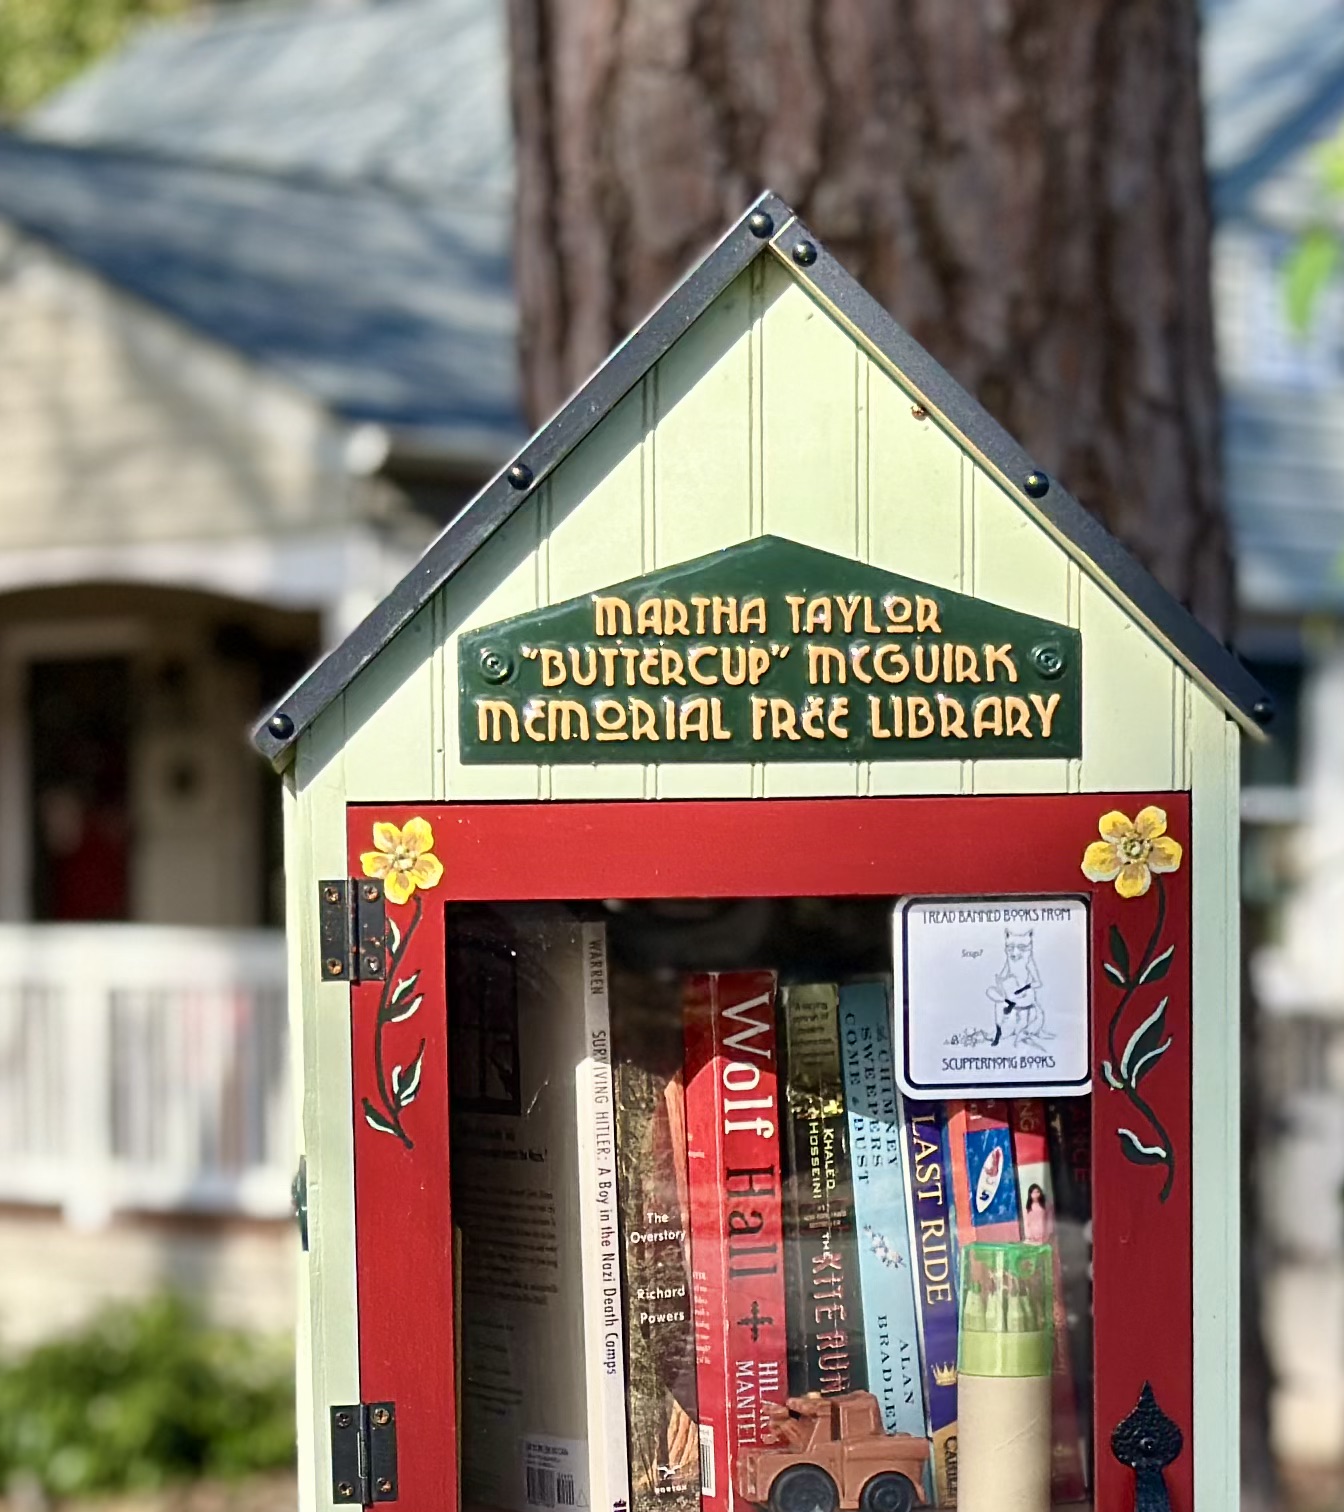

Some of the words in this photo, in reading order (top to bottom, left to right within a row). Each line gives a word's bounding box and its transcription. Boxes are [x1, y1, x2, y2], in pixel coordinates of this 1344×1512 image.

[592, 595, 767, 636] MARTHA
[785, 595, 942, 634] TAYLOR
[521, 644, 789, 687] "BUTTERCUP"
[808, 643, 1018, 684] MCGUIRK
[476, 697, 731, 743] MEMORIAL
[751, 696, 849, 740] FREE
[868, 693, 1060, 739] LIBRARY
[958, 909, 1001, 923] BANNED
[1004, 909, 1039, 922] BOOKS
[1041, 908, 1071, 921] FROM
[590, 940, 603, 995] WARREN
[592, 1031, 609, 1104] SURVIVING
[722, 992, 775, 1139] Wolf
[942, 1057, 1017, 1071] SCUPPERNONG
[1020, 1056, 1056, 1069] BOOKS
[845, 1012, 861, 1086] COME
[853, 1118, 870, 1185] DUST
[861, 1027, 884, 1168] SWEEPERS
[878, 1049, 899, 1166] CHIMNEY
[595, 1111, 612, 1161] HITLER:
[808, 1122, 822, 1199] HOSSEINI
[823, 1128, 836, 1190] KHALED
[912, 1114, 943, 1205] LAST
[596, 1181, 612, 1206] Boy
[598, 1167, 612, 1176] A
[599, 1208, 610, 1222] in
[600, 1226, 615, 1247] the
[630, 1229, 686, 1245] Overstory
[647, 1212, 669, 1224] The
[726, 1164, 778, 1281] Hall
[601, 1253, 616, 1283] Nazi
[920, 1218, 952, 1305] RIDE
[603, 1288, 619, 1327] Death
[637, 1285, 686, 1300] Richard
[812, 1252, 848, 1325] KITE
[640, 1311, 685, 1325] Powers
[603, 1334, 619, 1375] Camps
[877, 1315, 898, 1436] BRADLEY
[899, 1339, 915, 1405] ALAN
[736, 1360, 757, 1449] MANTEL
